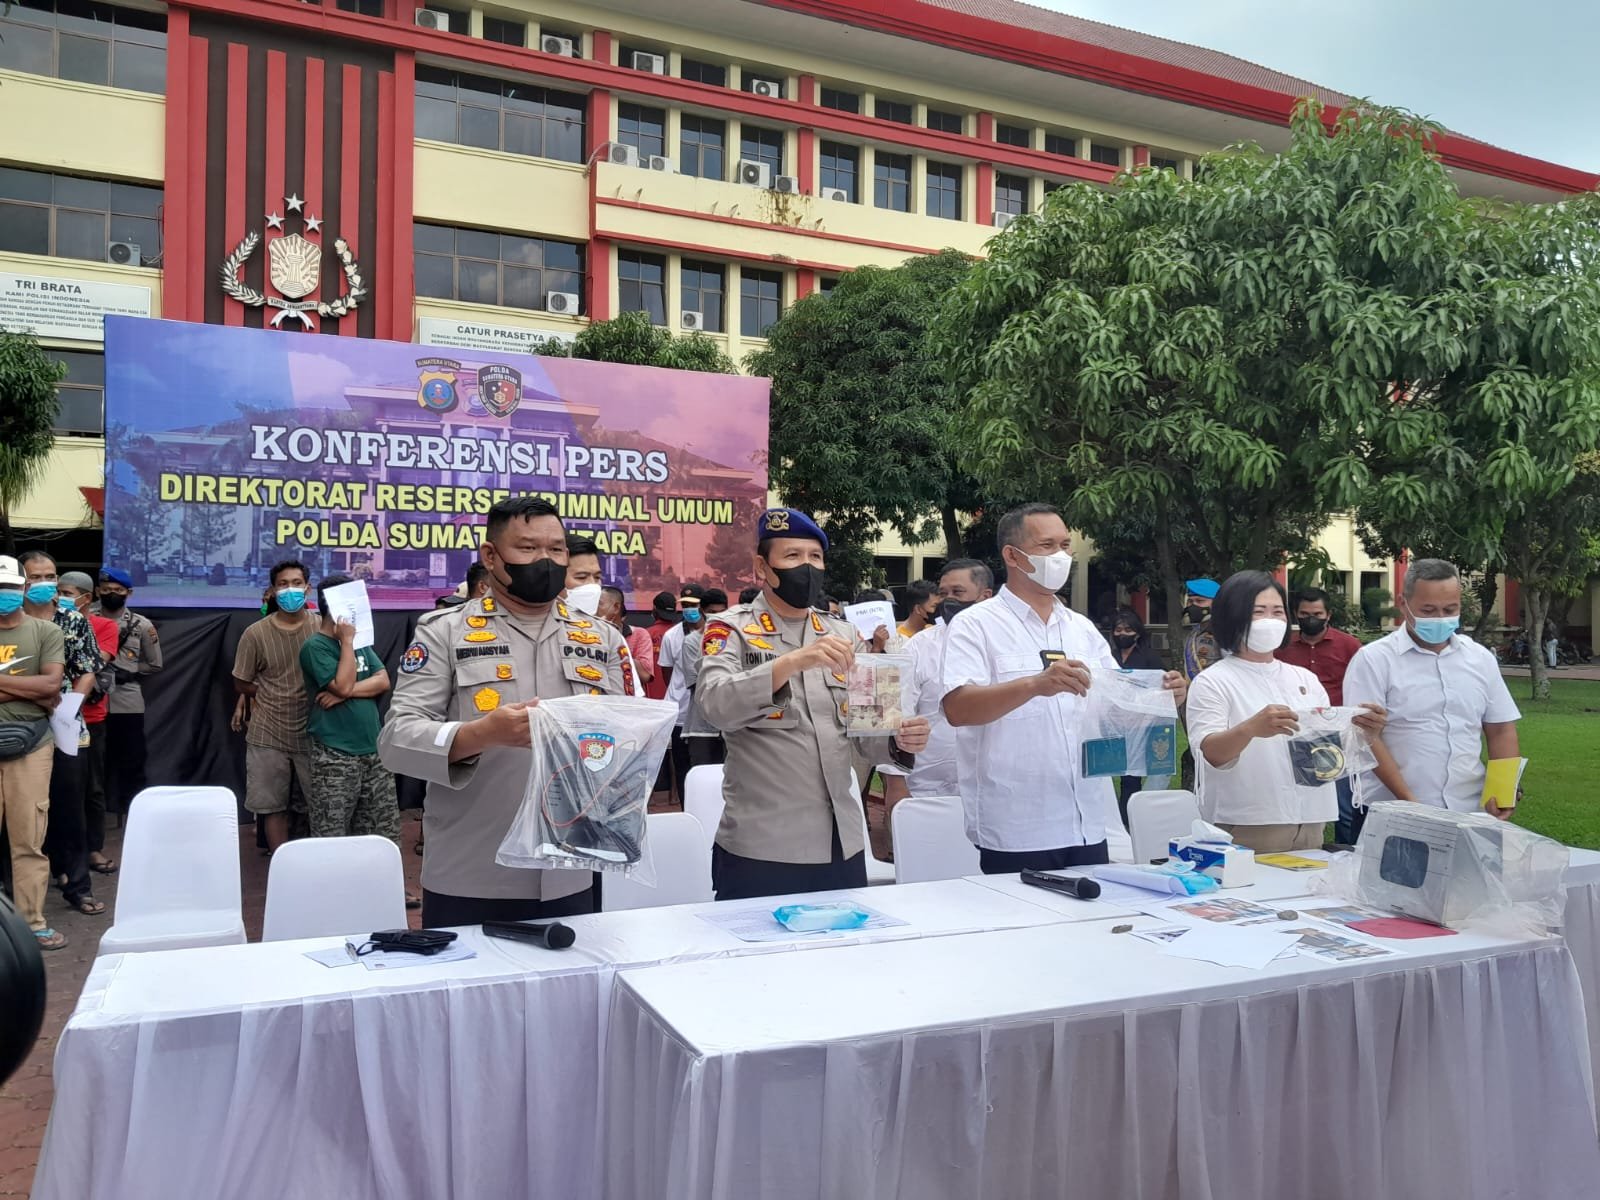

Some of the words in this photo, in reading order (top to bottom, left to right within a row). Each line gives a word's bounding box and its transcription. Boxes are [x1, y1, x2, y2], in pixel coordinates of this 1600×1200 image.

[15, 280, 36, 289] TRI
[41, 283, 82, 293] BRATA
[457, 325, 491, 337] CATUR
[494, 330, 544, 342] PRASETYA
[489, 366, 510, 375] POLDA
[251, 425, 551, 476] KONFERENSI
[564, 445, 669, 483] PERS
[160, 472, 367, 509] DIREKTORAT
[520, 490, 650, 521] IMINAL
[657, 498, 733, 524] UMUM
[276, 519, 381, 547] POLDA
[563, 645, 608, 663] POLRI
